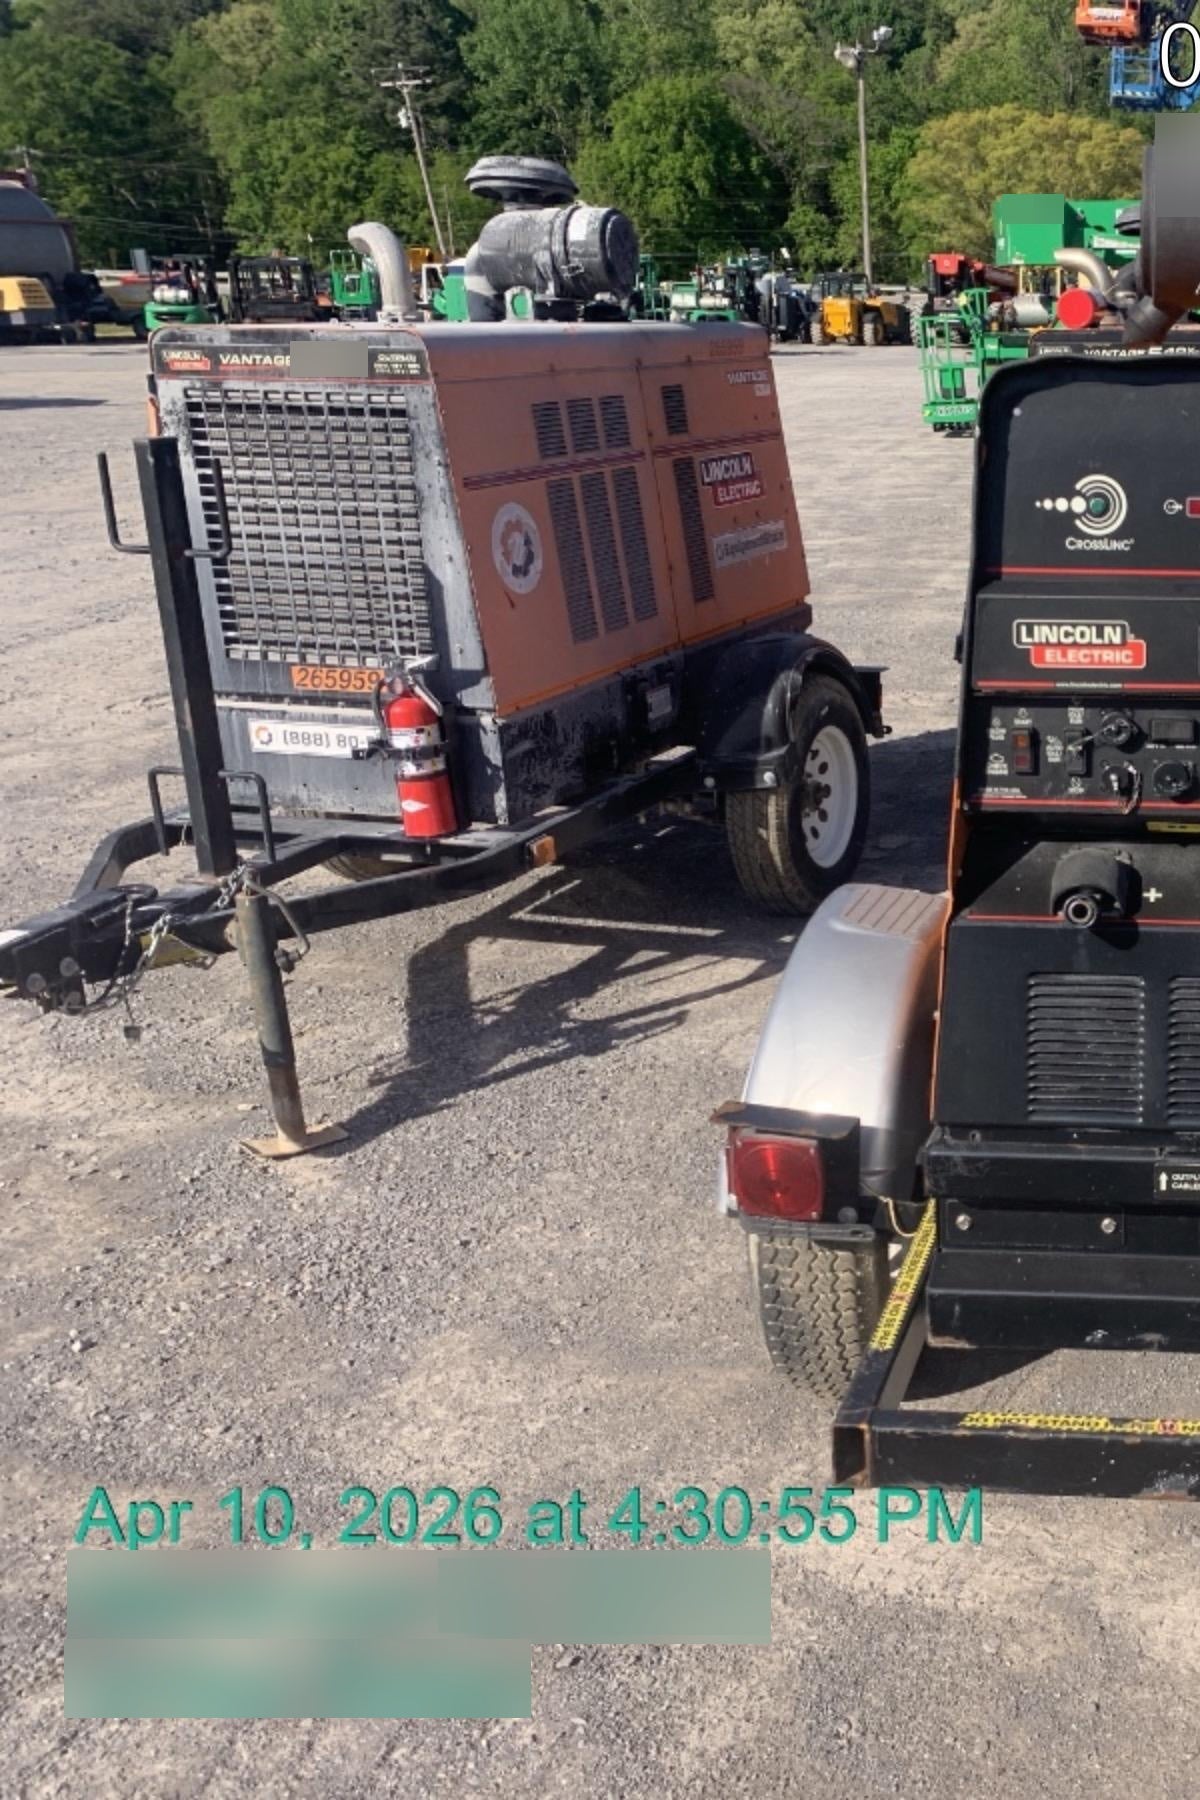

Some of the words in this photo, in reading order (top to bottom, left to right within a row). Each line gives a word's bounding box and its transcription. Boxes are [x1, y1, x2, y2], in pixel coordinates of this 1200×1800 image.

[701, 457, 753, 483] LINCOLN
[717, 481, 762, 503] ELECTRIC
[1020, 624, 1122, 645] LINCOLN
[1044, 648, 1134, 664] ELECTRIC
[295, 668, 381, 690] 265959
[282, 729, 330, 748] (888)
